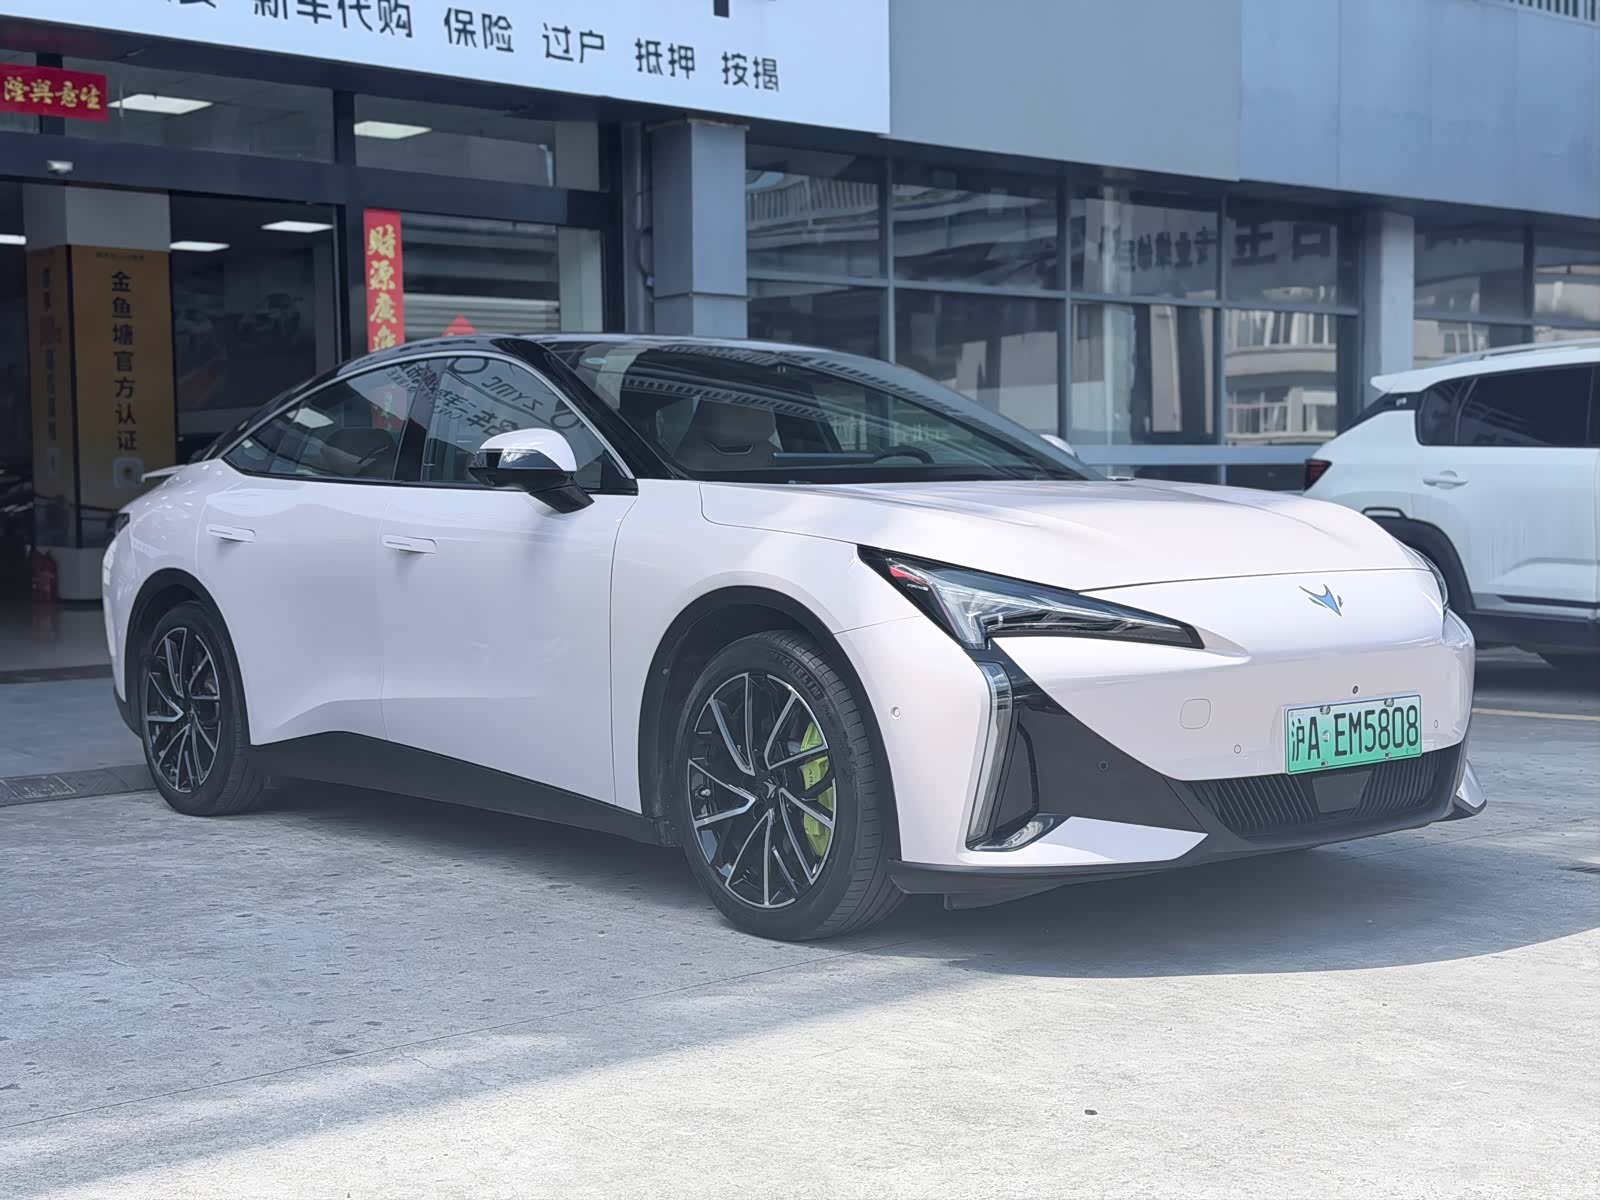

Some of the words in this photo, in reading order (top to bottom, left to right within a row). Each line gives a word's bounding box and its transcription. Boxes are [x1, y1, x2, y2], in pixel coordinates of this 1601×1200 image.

[444, 7, 514, 53] 保险
[542, 22, 605, 63] 过户
[634, 37, 695, 80] 抵押
[721, 51, 780, 92] 按揭
[111, 269, 136, 451] 金鱼塘官方认证
[1291, 717, 1321, 762] 沪A
[1333, 704, 1419, 757] EM5808
